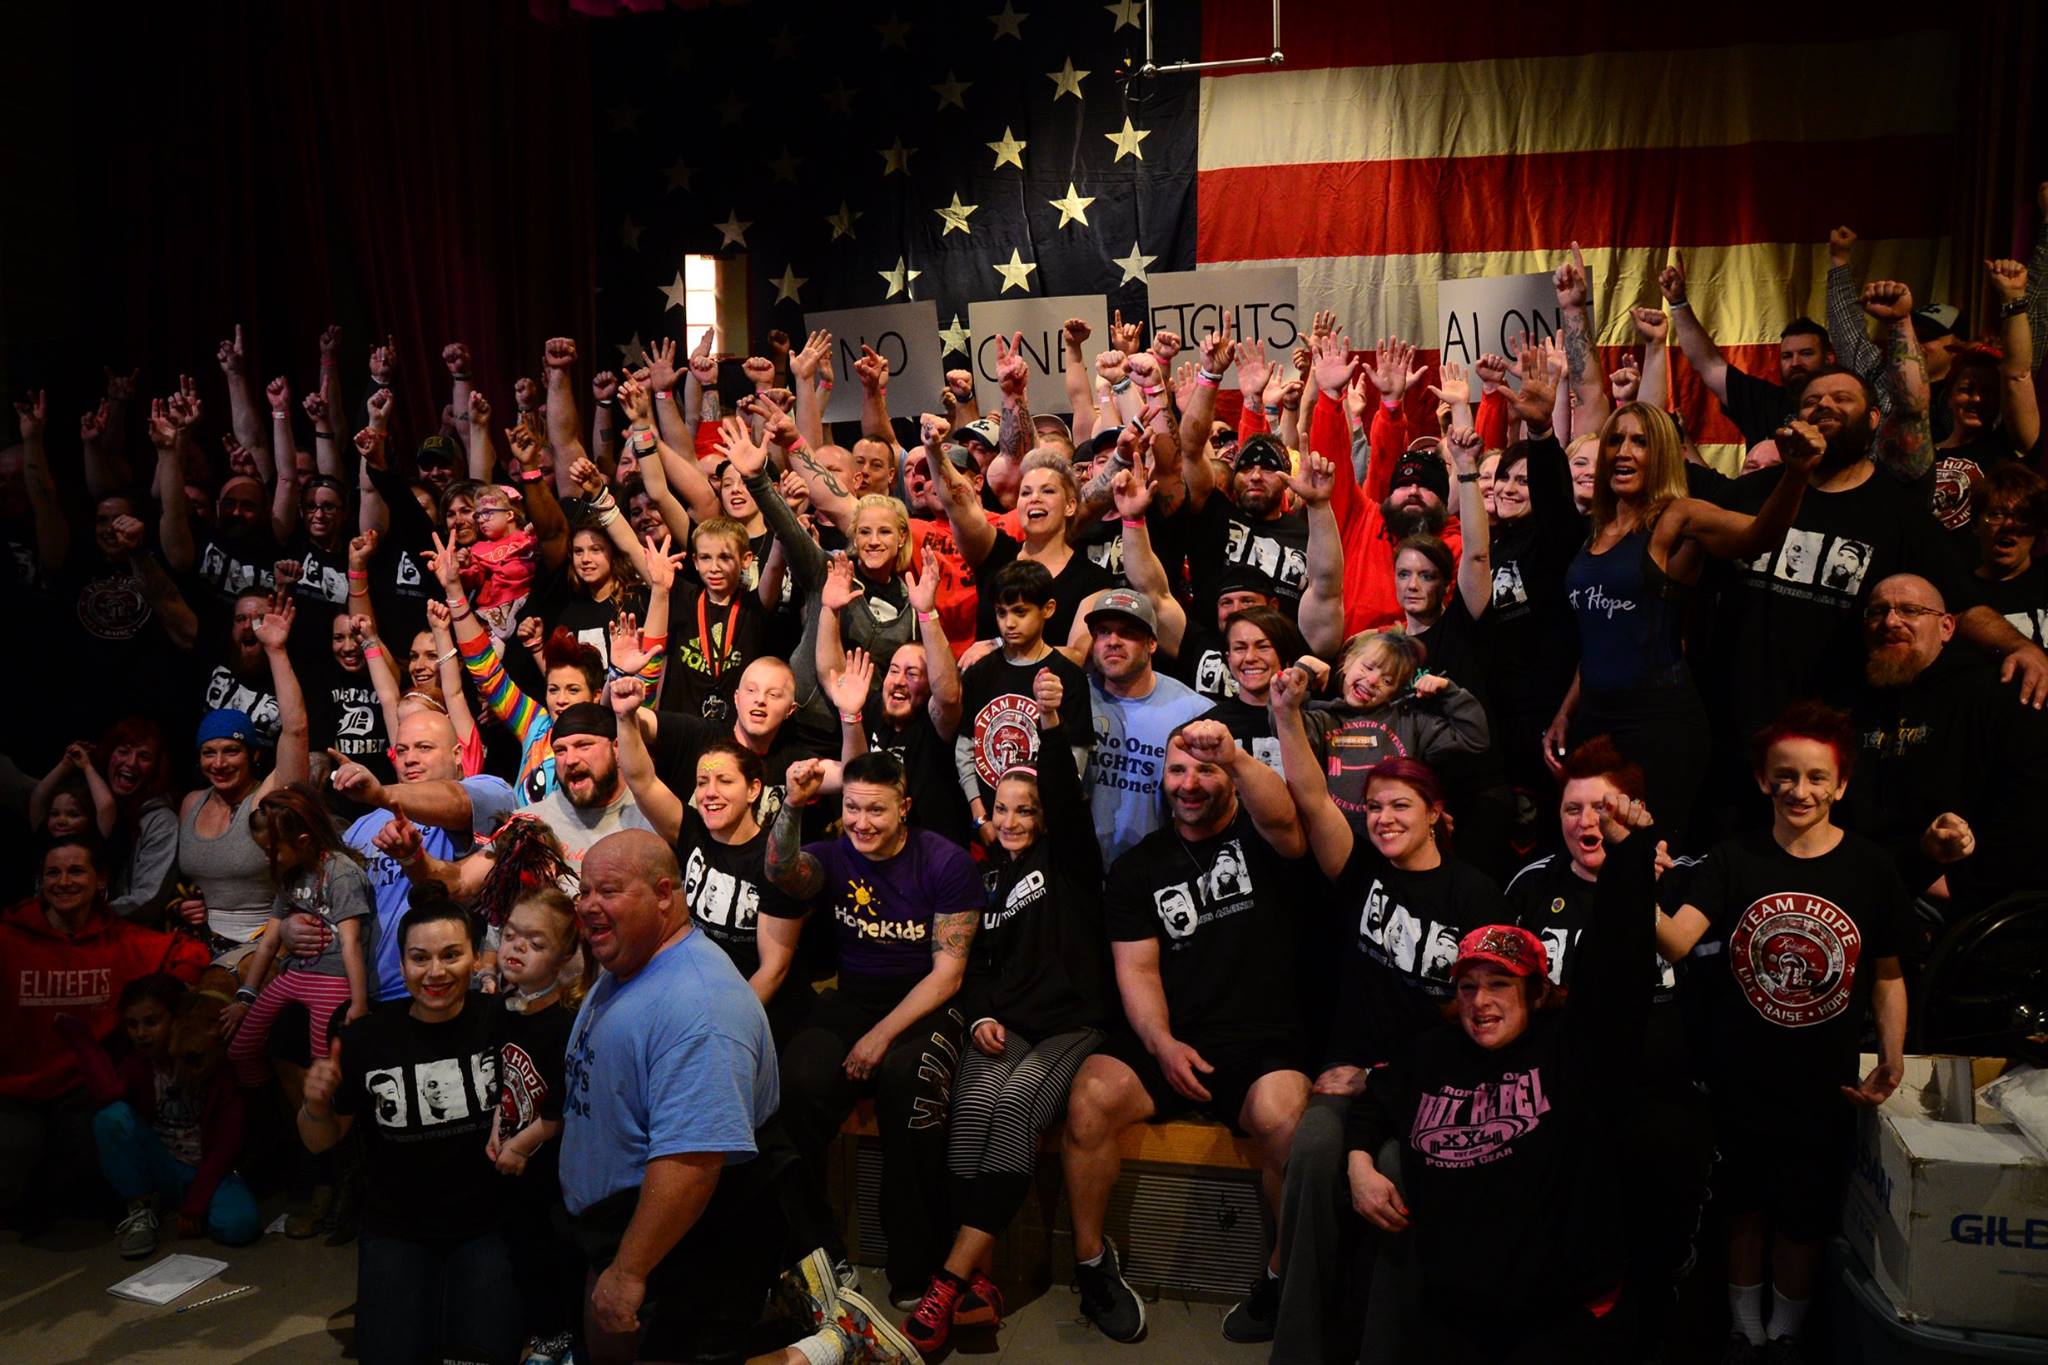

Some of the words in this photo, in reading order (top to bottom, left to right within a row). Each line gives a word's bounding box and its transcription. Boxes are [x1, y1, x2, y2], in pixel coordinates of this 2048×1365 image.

[1150, 303, 1298, 350] FIGHTS
[1443, 301, 1593, 366] ALON
[839, 330, 907, 382] NO
[1584, 583, 1637, 620] Hope
[976, 697, 1010, 729] TEAM
[1087, 752, 1155, 777] IGHTS
[1125, 738, 1165, 758] One
[1741, 898, 1796, 934] TEAM
[1805, 900, 1858, 948] HOPE
[19, 968, 112, 997] ELITEFTS
[1764, 1002, 1804, 1022] RAISE
[1817, 987, 1851, 1016] HOPE
[511, 1051, 545, 1099] HOPE
[1442, 1130, 1496, 1149] XXL
[1425, 1157, 1476, 1169] POWER
